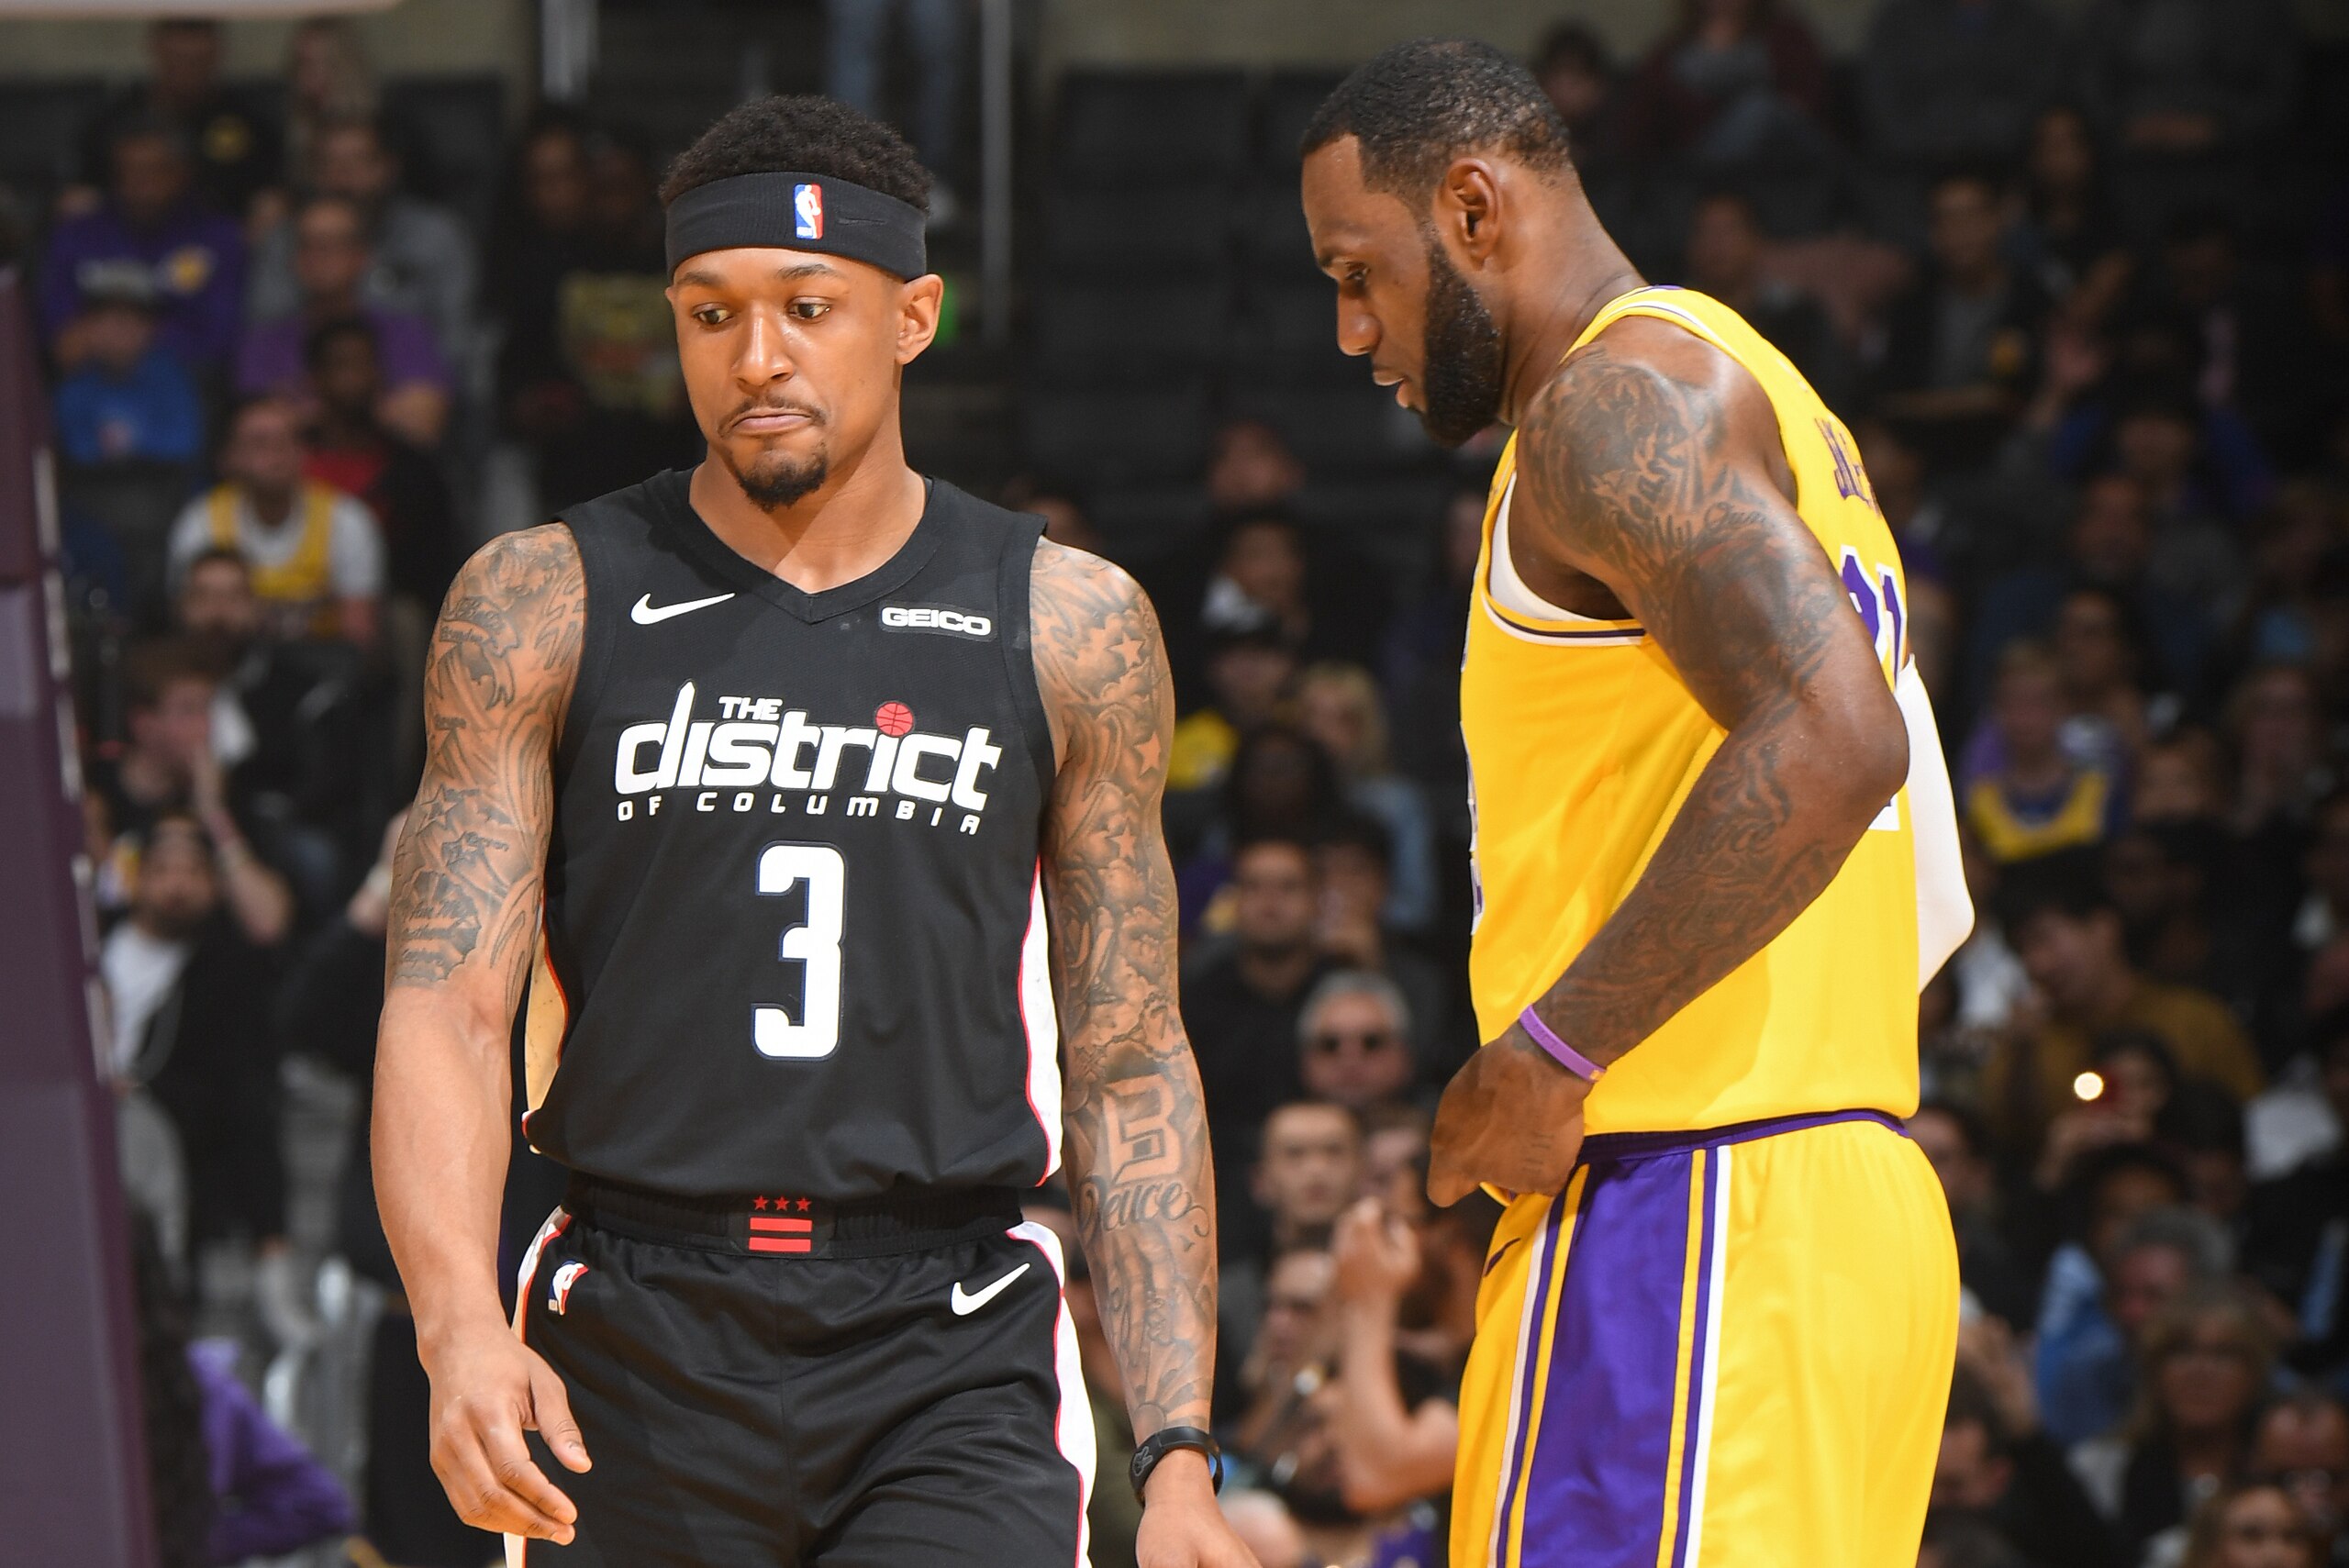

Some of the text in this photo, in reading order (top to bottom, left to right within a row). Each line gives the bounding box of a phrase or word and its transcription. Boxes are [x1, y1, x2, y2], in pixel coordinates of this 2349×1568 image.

[881, 606, 992, 636] GEICO
[718, 696, 784, 721] THE
[615, 681, 1003, 812] district
[618, 792, 981, 836] OF COLUMBIA
[754, 842, 849, 1060] 3
